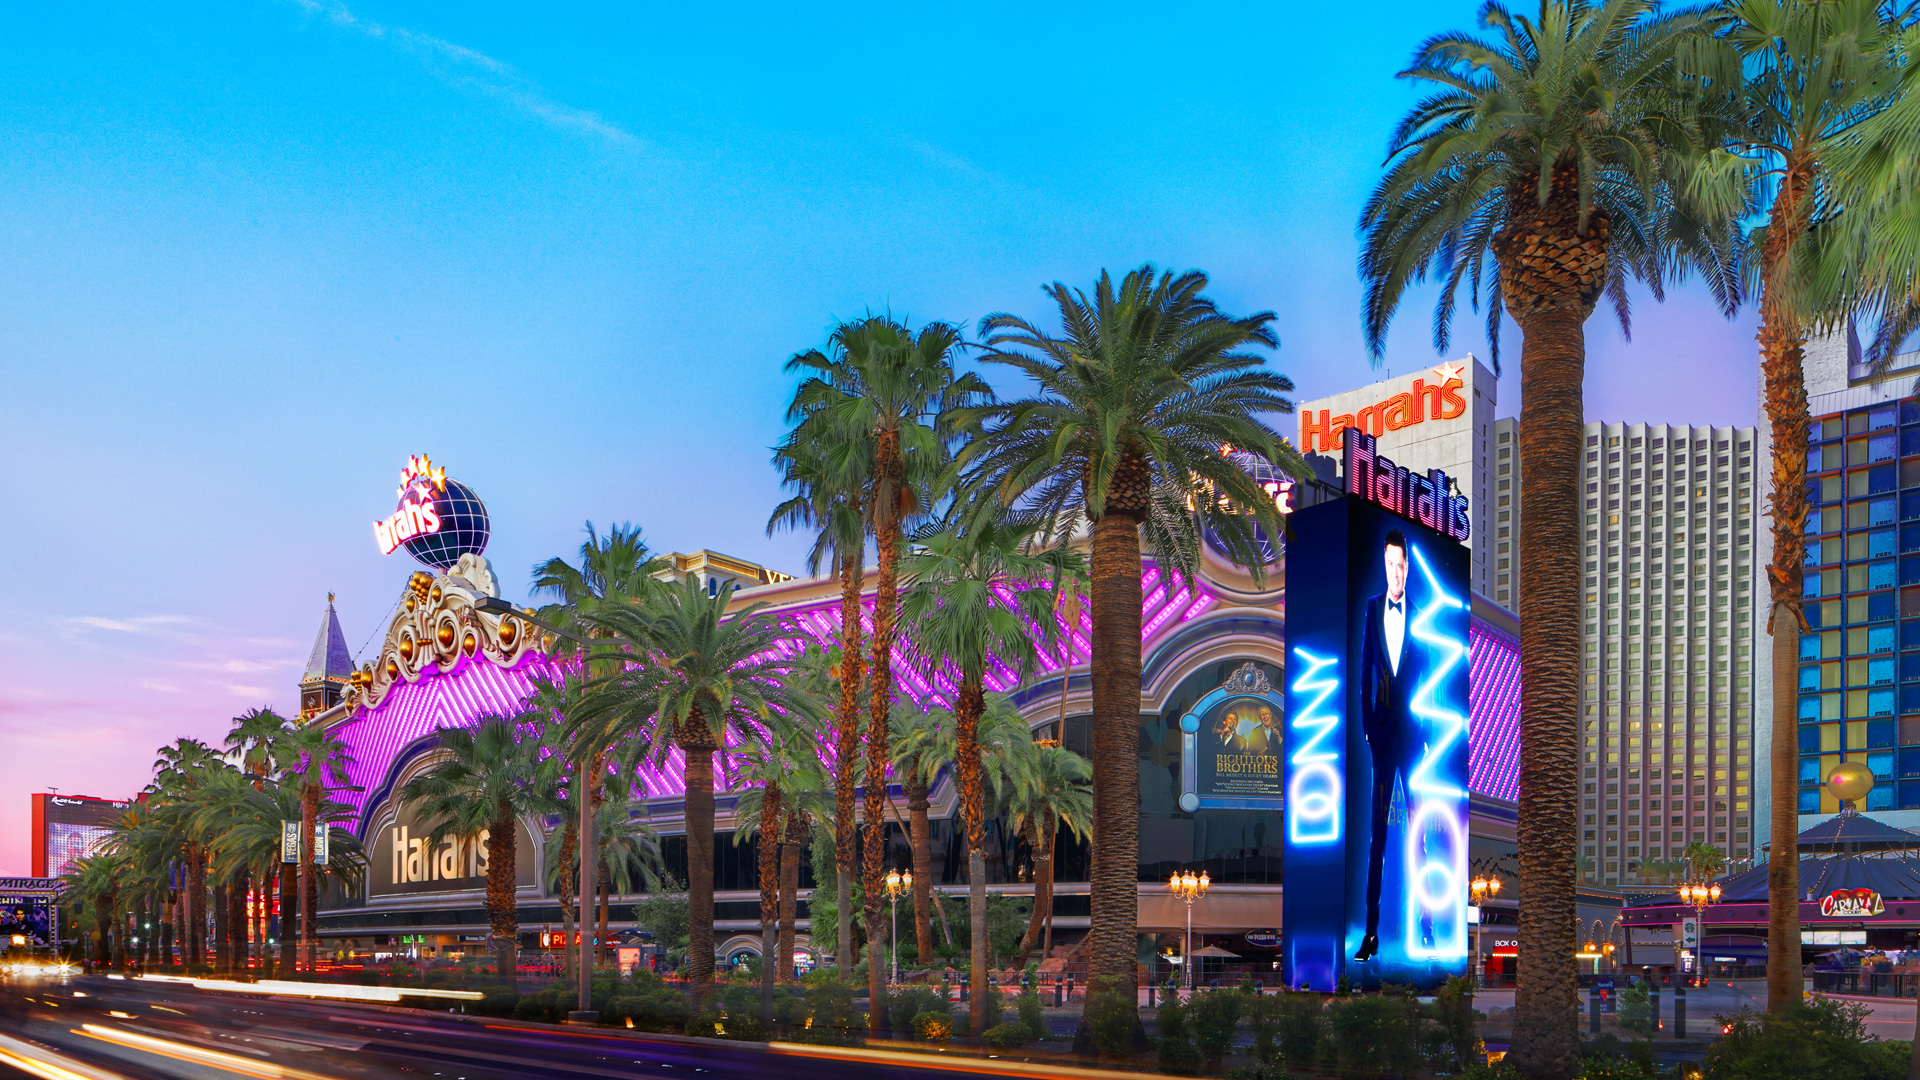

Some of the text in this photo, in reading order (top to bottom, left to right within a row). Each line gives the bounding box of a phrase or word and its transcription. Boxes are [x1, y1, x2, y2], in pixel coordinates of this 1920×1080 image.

[1291, 646, 1339, 843] DONNY
[1407, 543, 1464, 957] DONNY
[1216, 754, 1278, 764] RIGHTEOUS
[1216, 763, 1278, 774] BROTHERS
[286, 832, 297, 856] VEGAS
[0, 879, 55, 890] MIRAGE
